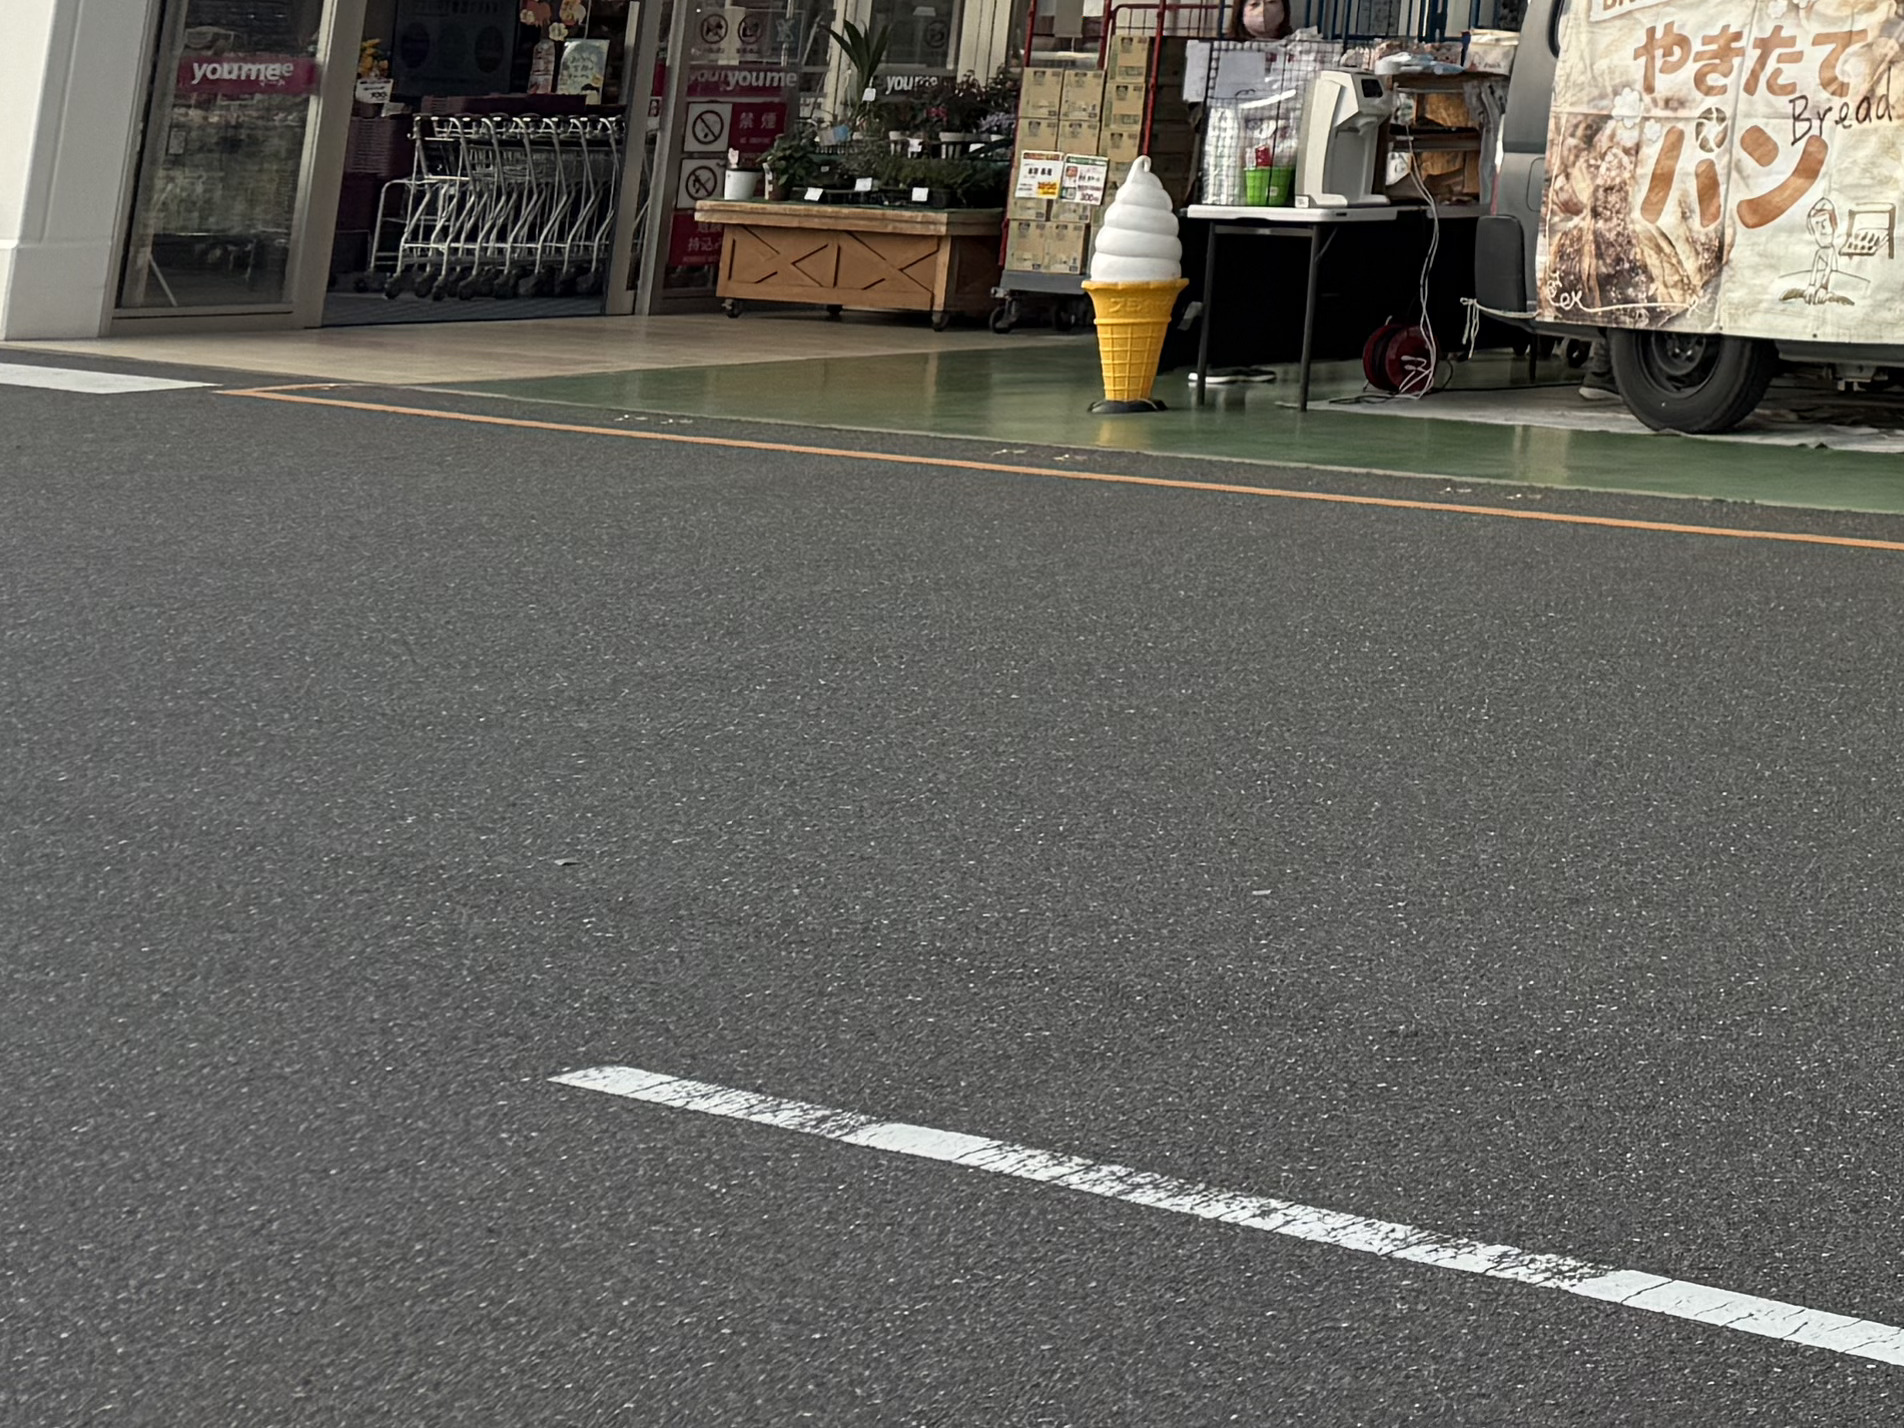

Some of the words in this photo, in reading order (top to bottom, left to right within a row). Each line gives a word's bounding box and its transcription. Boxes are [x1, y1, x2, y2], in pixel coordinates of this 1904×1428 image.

[726, 70, 798, 91] youme
[1633, 20, 1869, 98] やきたて
[1788, 64, 1894, 148] Bread
[1641, 105, 1829, 230] パン
